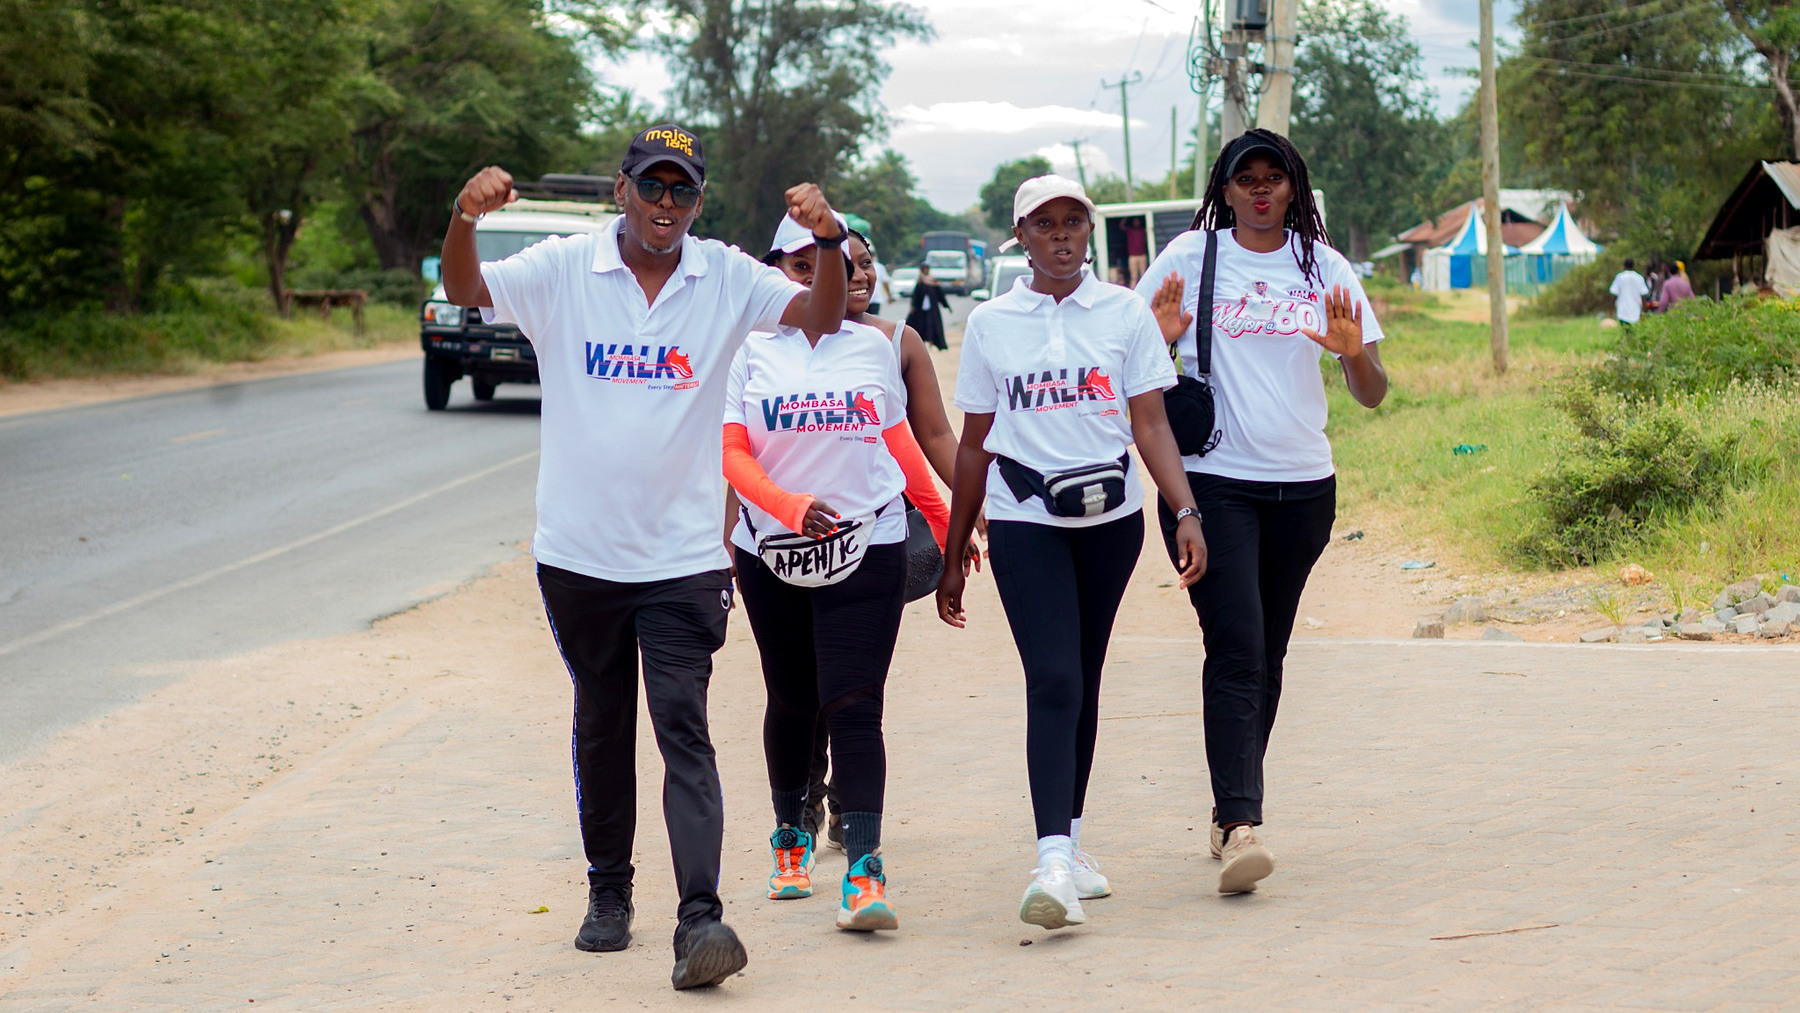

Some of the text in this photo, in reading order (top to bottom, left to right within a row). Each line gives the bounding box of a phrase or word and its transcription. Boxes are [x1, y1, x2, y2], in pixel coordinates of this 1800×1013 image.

[645, 129, 693, 146] major
[585, 341, 680, 379] WALK
[1005, 366, 1100, 411] WALK
[1026, 380, 1066, 390] MOMBASA
[761, 391, 864, 432] WALK
[780, 400, 844, 411] MOMBASA
[1036, 402, 1078, 413] MOVEMENT
[796, 423, 865, 433] MOVEMENT
